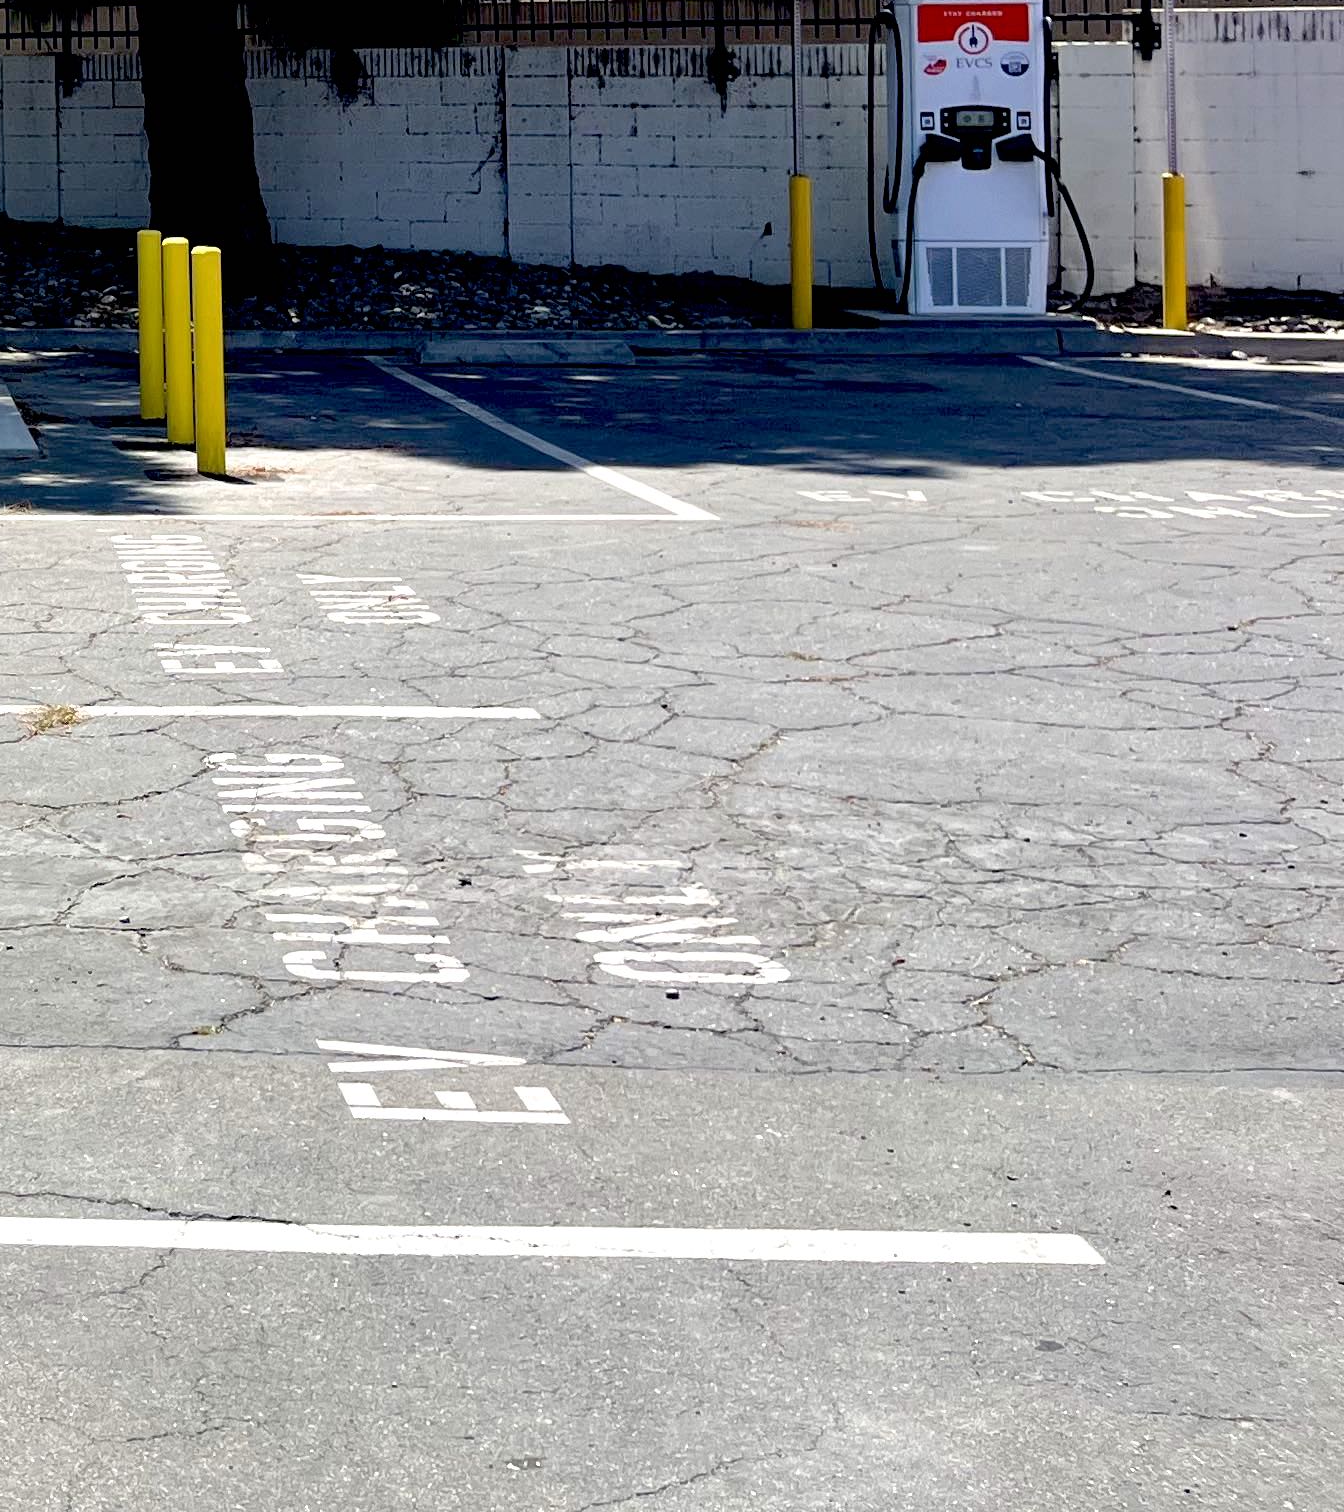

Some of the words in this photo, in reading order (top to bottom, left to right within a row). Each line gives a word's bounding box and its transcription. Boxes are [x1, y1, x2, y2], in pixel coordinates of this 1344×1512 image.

[956, 57, 992, 69] EVCS
[110, 534, 252, 625] CHARGING
[296, 573, 441, 624] ONLY
[153, 641, 284, 673] EV
[201, 752, 471, 983] CHARGING
[512, 848, 791, 984] ONLY
[315, 1038, 572, 1125] EV
